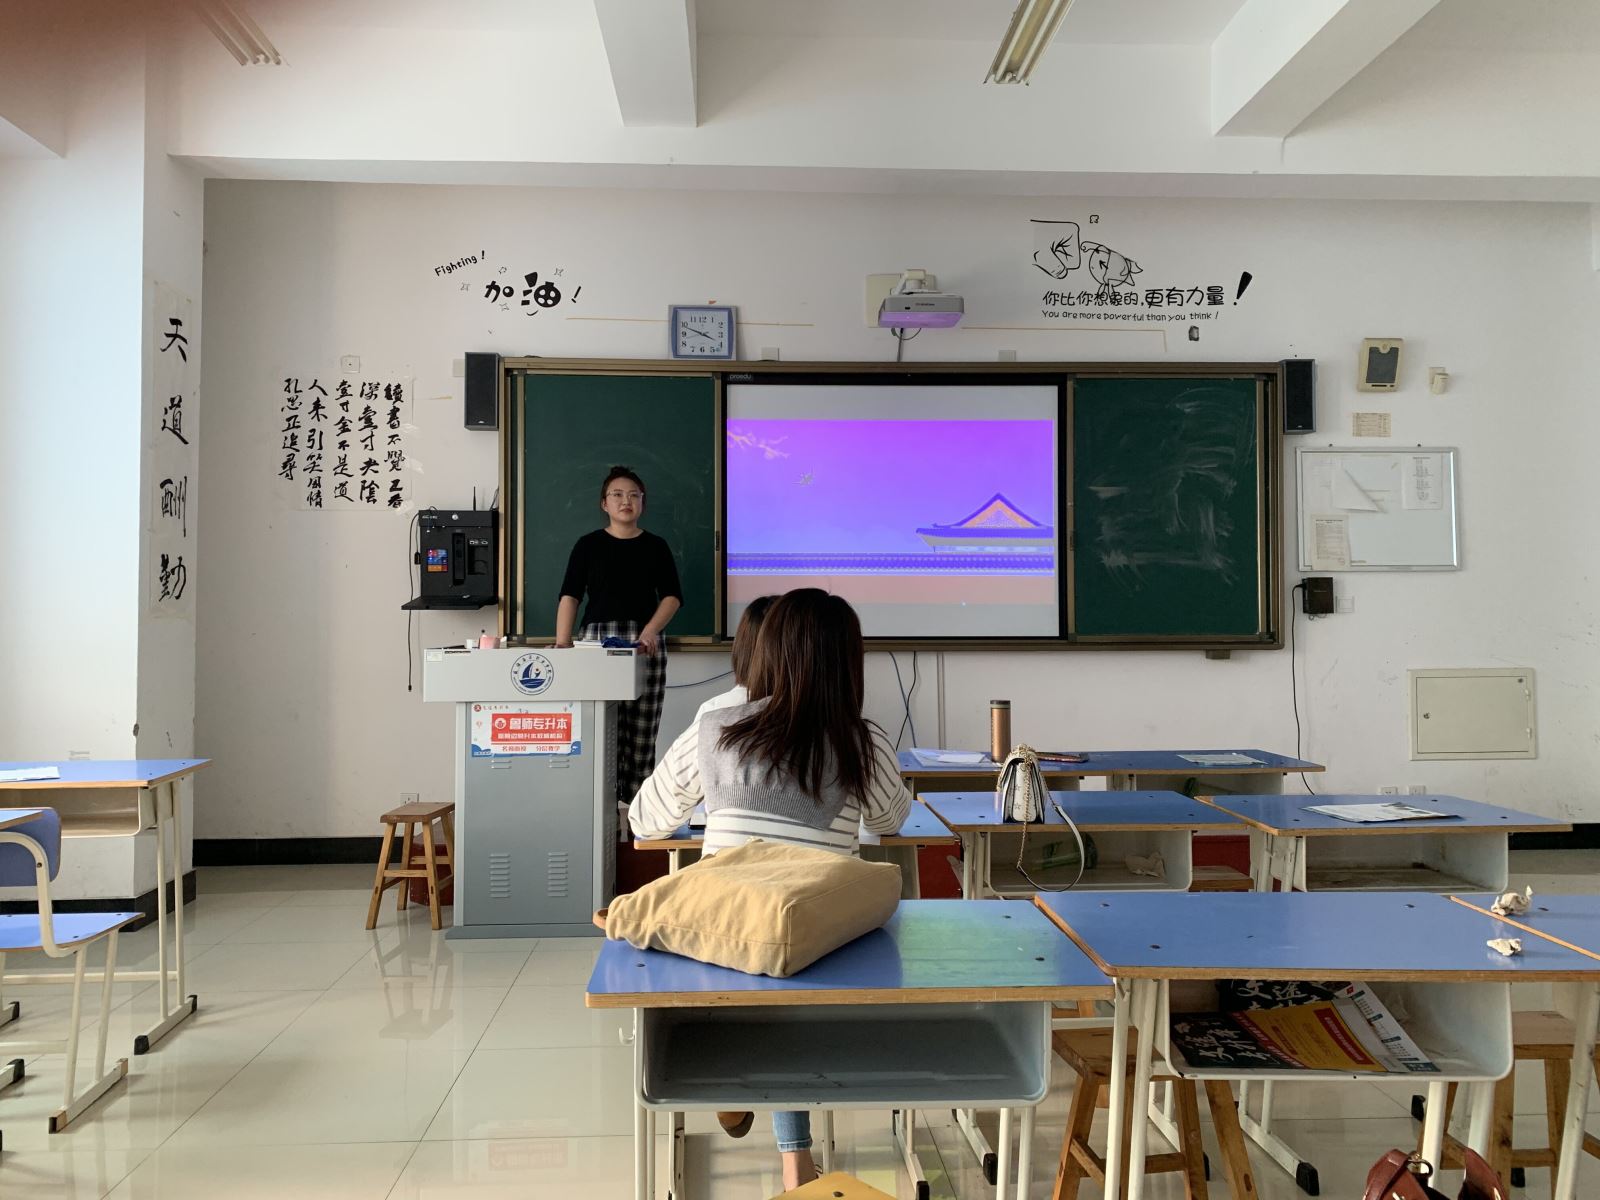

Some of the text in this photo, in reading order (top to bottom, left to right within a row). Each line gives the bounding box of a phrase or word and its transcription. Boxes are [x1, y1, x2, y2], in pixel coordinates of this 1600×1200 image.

[1041, 309, 1060, 319] You
[1062, 311, 1078, 320] are
[1079, 311, 1102, 320] more
[1103, 312, 1145, 321] powerful
[1146, 312, 1167, 321] than
[1168, 312, 1186, 322] you
